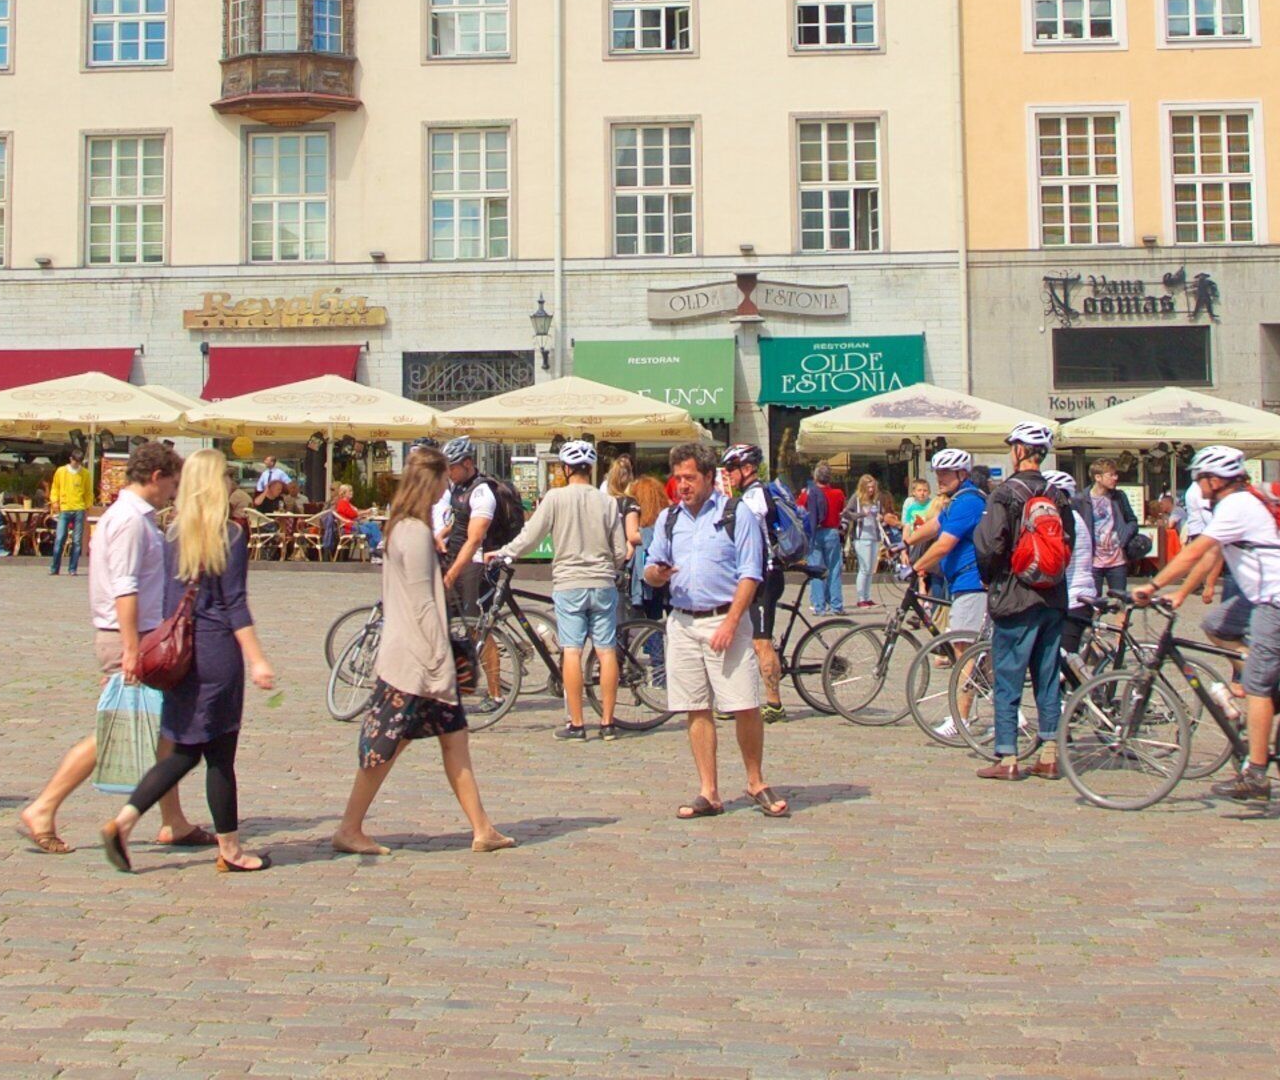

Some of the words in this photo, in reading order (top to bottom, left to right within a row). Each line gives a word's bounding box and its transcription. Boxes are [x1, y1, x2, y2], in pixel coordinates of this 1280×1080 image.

[1088, 275, 1146, 295] Vana
[199, 287, 369, 318] Revalia
[764, 288, 839, 309] ESTONIA
[813, 342, 870, 351] RESTORAN
[628, 356, 681, 365] RESTORAN
[801, 352, 883, 374] OLDE
[782, 371, 904, 393] ESTONIA
[665, 386, 724, 405] INN
